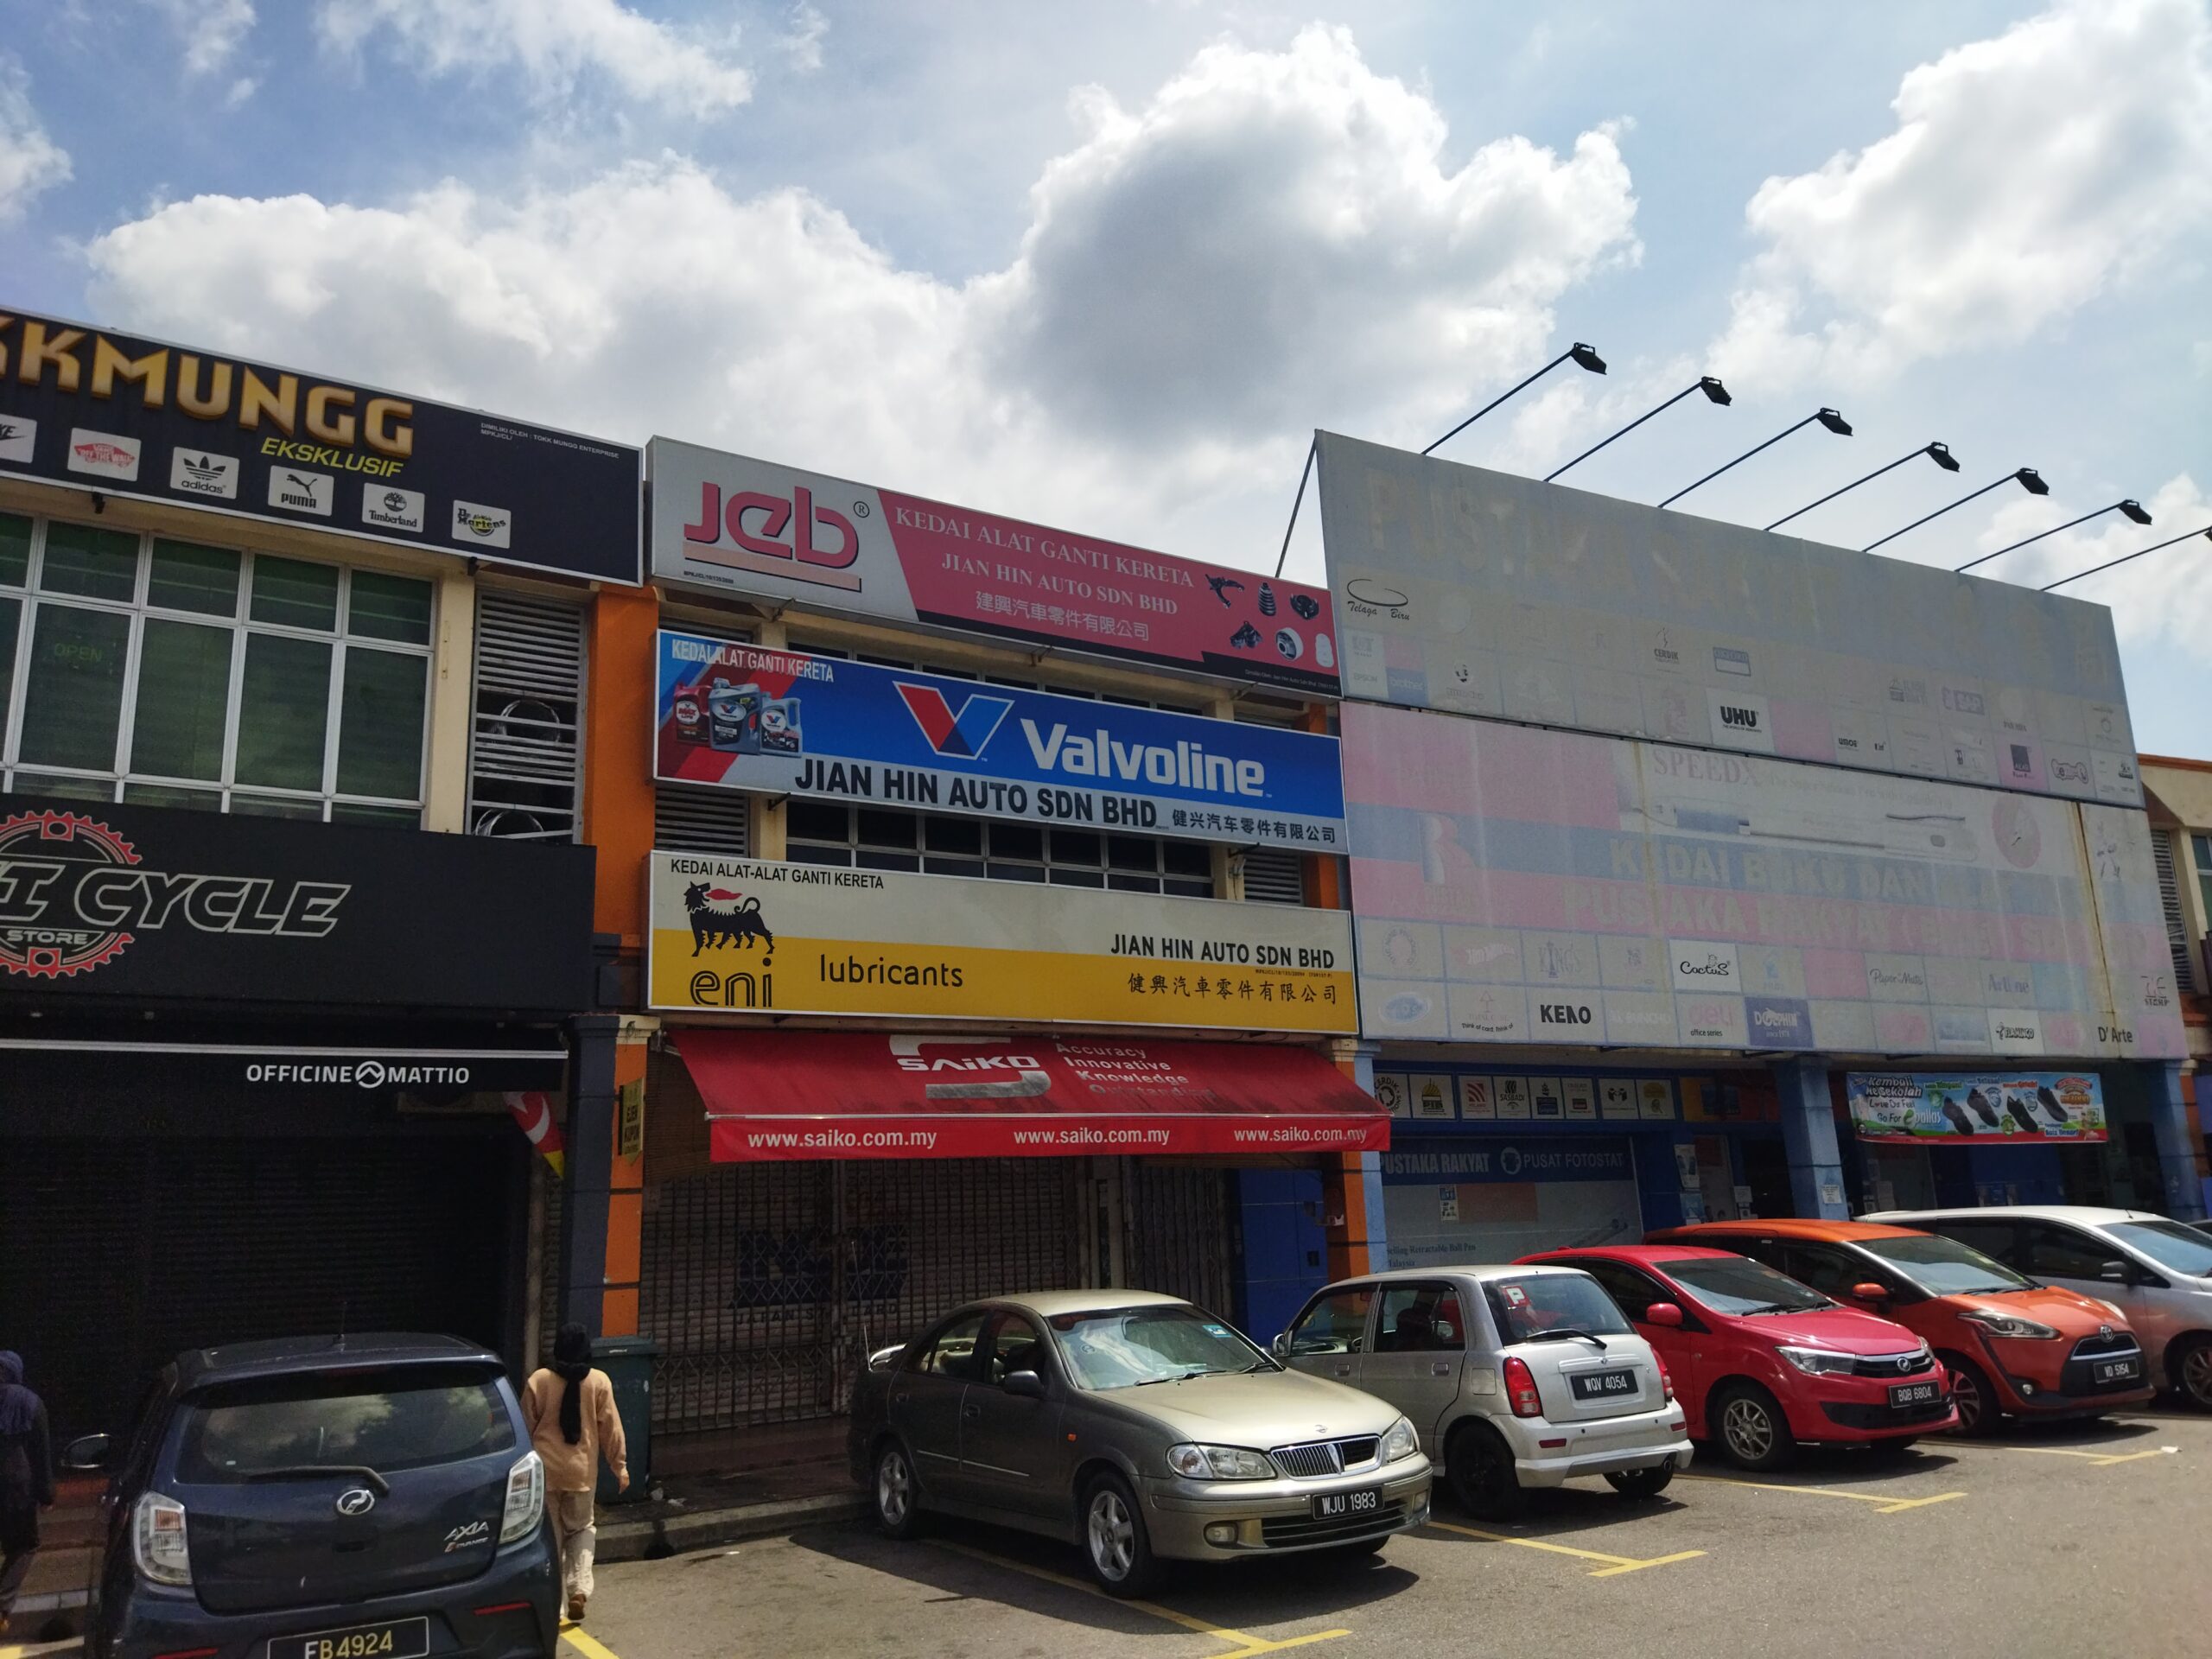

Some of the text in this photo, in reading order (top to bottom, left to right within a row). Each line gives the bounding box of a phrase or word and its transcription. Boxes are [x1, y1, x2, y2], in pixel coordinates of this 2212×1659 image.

[0, 315, 414, 459] KMUNGG
[261, 436, 404, 478] EKSKLUSIF
[579, 444, 620, 459] ENTERPRISE
[181, 479, 223, 494] adidas
[281, 493, 317, 509] PUMA
[369, 510, 417, 528] Timberland
[895, 507, 1194, 588] KEDAI ALAT GANTI KERETA
[942, 554, 1178, 615] JIAN HIN AUTO SDN BHD
[976, 589, 1150, 642] 建興汽車零件有限公司
[1347, 601, 1410, 621] Telaga Biru
[672, 639, 835, 683] KEDAI ALAT GANTI KERETA
[1719, 705, 1757, 728] UHU
[1020, 718, 1265, 798] Valvoline
[795, 759, 1157, 828] JIAN HIN AUTO SDN BHD
[1172, 809, 1336, 844] 健兴汽车零件有限公司
[671, 859, 884, 890] KEDAI ALAT-ALAT GANTI KERETA
[1612, 836, 1729, 883] KDAI
[1859, 863, 1929, 900] DAN
[73, 868, 352, 938] CYCLE
[1565, 881, 1748, 936] PUSAKA
[7, 929, 89, 946] STORE
[1111, 934, 1334, 969] JIAN HIN AUTO SDN BHD
[690, 957, 772, 1007] eni
[820, 953, 963, 988] lubricants
[1127, 972, 1337, 1006] 健興汽車零件有限公司
[1988, 974, 2030, 994] Artlne
[1754, 1009, 1798, 1027] DOLPHIN
[1056, 1043, 1146, 1059] Accuracy
[246, 1063, 469, 1085] OFFICINE MATTIO
[1064, 1056, 1172, 1071] Innovative
[1076, 1070, 1190, 1085] Knowledge
[1877, 1113, 1887, 1122] Go
[1890, 1112, 1902, 1122] For
[748, 1128, 938, 1150] www.saiko.com.my
[1014, 1126, 1171, 1147] www.saiko.com.my
[1234, 1126, 1367, 1144] www.saiko.com.my
[1382, 1152, 1624, 1176] USTAKA RAKYAT PUSAT FOTOSTAT
[1409, 1244, 1448, 1255] Retractable
[1449, 1243, 1462, 1253] Ball
[1463, 1243, 1477, 1252] Pen
[1584, 1375, 1628, 1392] WQV 4054
[1913, 1385, 1932, 1400] 6804
[1322, 1491, 1376, 1515] WJU 1983
